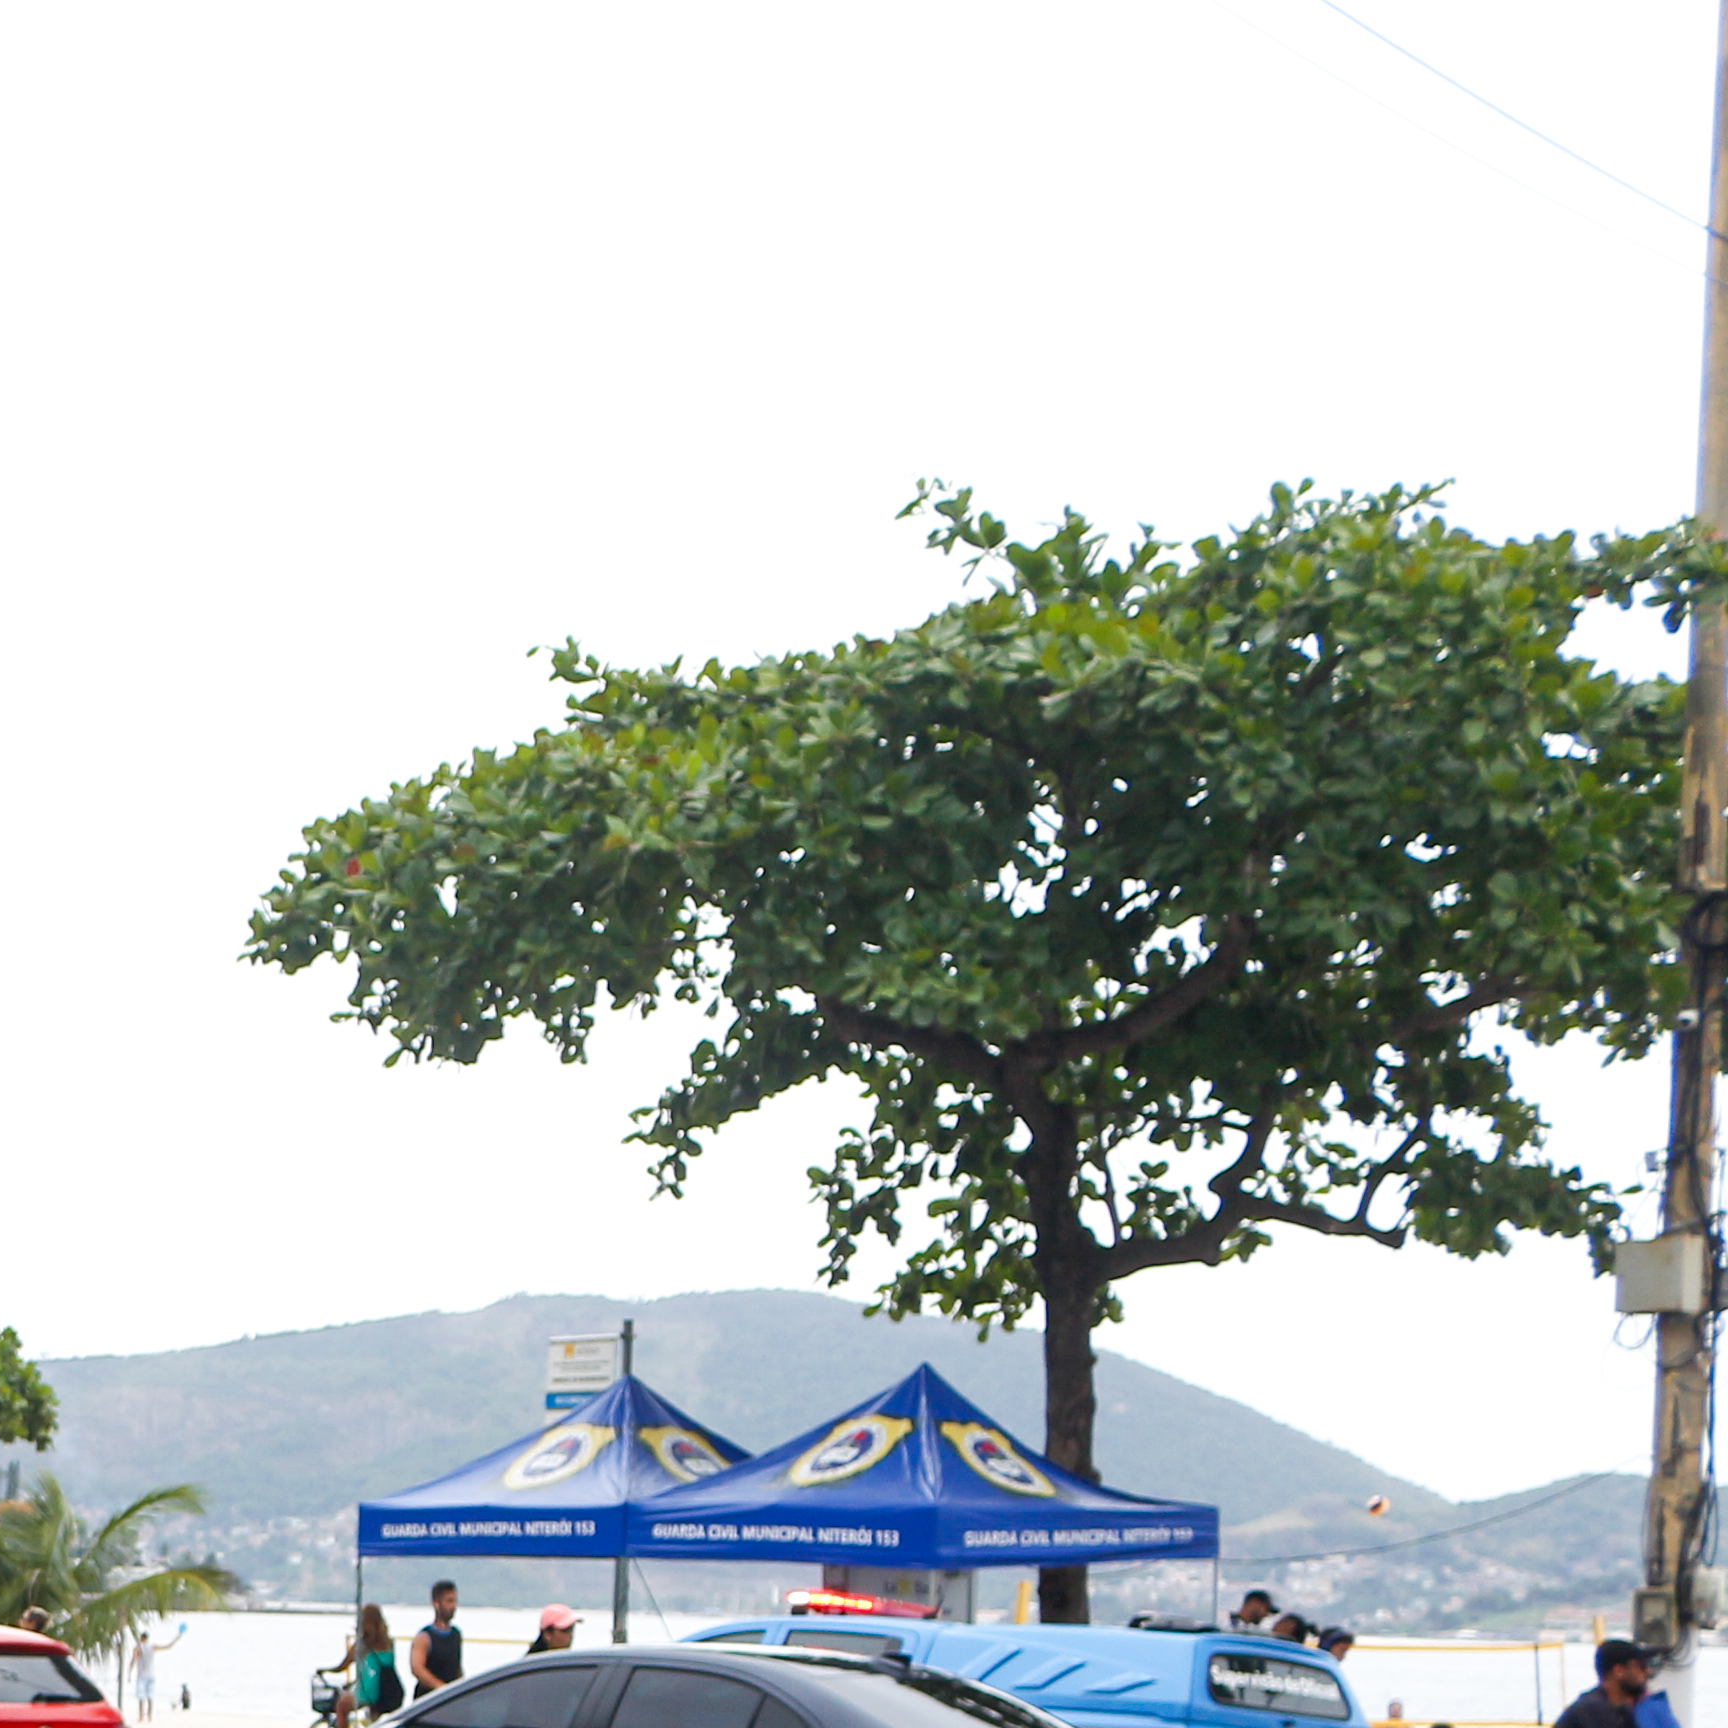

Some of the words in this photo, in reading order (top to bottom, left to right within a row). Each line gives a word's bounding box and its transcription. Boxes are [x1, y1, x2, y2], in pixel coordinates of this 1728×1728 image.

[382, 1523, 427, 1538] GUARDA
[430, 1523, 456, 1538] CIVIL
[458, 1521, 522, 1537] MUNICIPAL
[652, 1523, 704, 1539] GUARDA
[707, 1524, 739, 1541] CIVIL
[742, 1524, 816, 1543] MUNICIPAL
[964, 1531, 1017, 1548] GUARDA
[1019, 1530, 1050, 1547] CIVIL
[1052, 1529, 1121, 1546] MUNICIPAL
